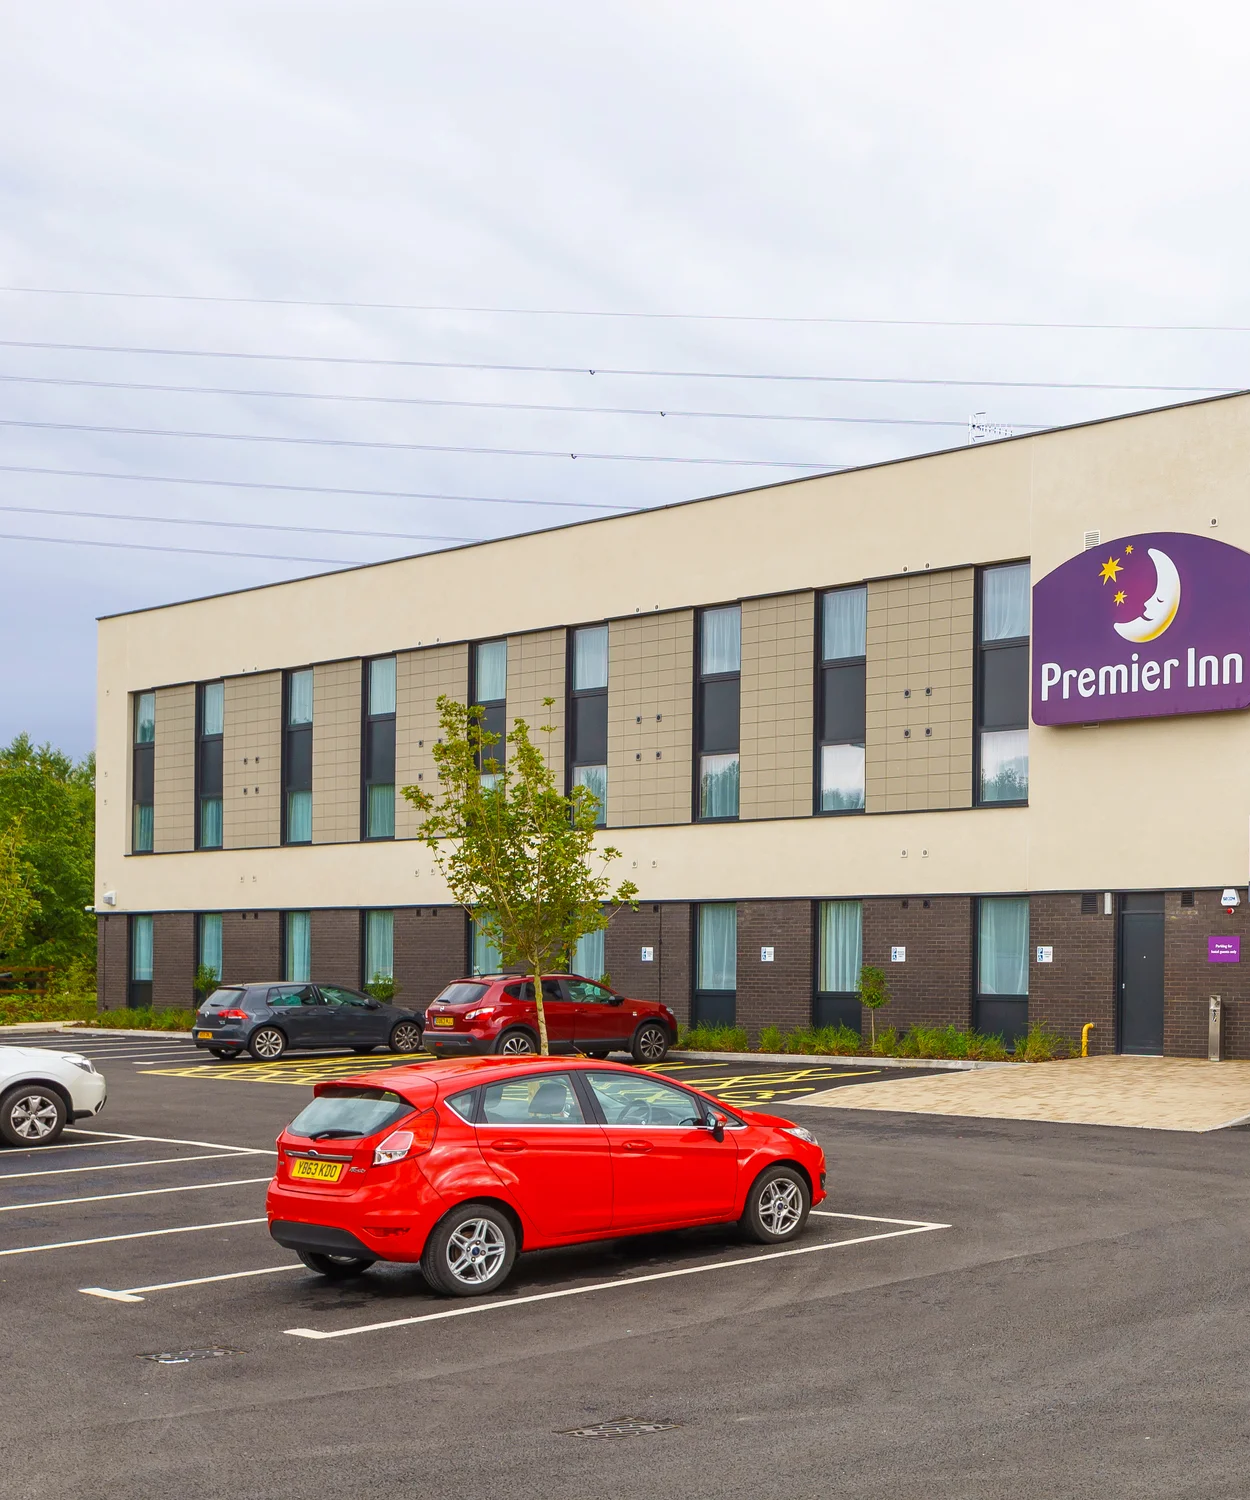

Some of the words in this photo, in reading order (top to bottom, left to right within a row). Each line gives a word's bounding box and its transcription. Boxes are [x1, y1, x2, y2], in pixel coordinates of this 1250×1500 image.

[1041, 653, 1180, 702] Premier
[1187, 647, 1243, 688] Inn
[297, 1161, 318, 1175] YB63
[318, 1163, 338, 1178] KDO
